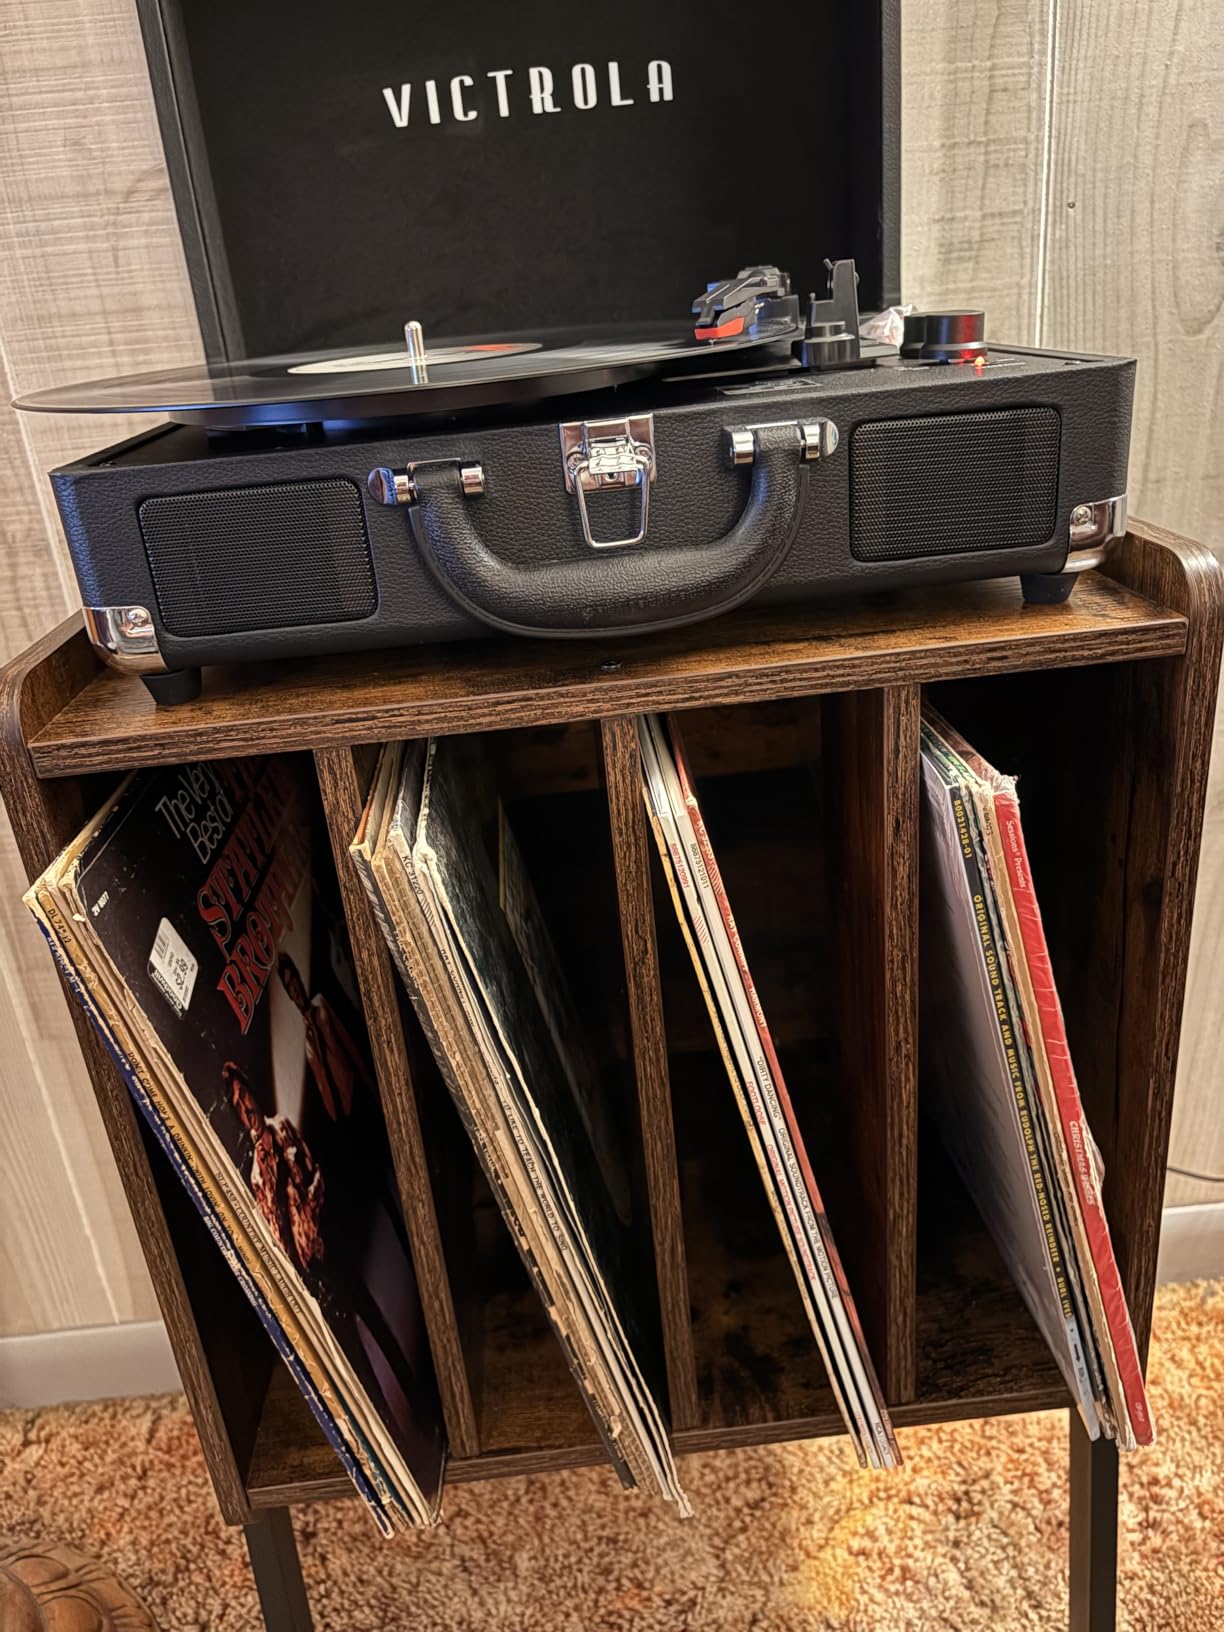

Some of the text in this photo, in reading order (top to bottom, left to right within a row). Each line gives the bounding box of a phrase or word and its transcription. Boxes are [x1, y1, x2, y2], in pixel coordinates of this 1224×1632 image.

[383, 60, 674, 128] VICTROLA
[155, 795, 196, 839] The
[187, 799, 227, 864] Best
[953, 799, 972, 859] B0021428-01
[690, 842, 710, 890] 88875121011
[1006, 819, 1026, 889] Sessions Presents
[401, 853, 424, 895] KC 31220
[506, 1113, 518, 1130] LIKE
[971, 893, 1073, 1319] ORIGINAL SOUND TRACK AND MUSIC FROM RUDOLPH THE RED-NOSED REINDEER BURL IVES
[514, 1133, 525, 1145] TO
[745, 1080, 766, 1127] FOOTLOOSE
[765, 1142, 782, 1177] ORIGINAL
[777, 1126, 795, 1162] ORIGINAL
[140, 1075, 158, 1098] COME
[225, 1223, 239, 1242] YO
[519, 1146, 538, 1173] TEACH
[531, 1174, 544, 1190] THE
[788, 1161, 810, 1210] SOUNDTRACK
[201, 1214, 214, 1229] BIG
[537, 1191, 556, 1220] WORLD
[803, 1210, 816, 1231] FROM
[234, 1204, 261, 1245] COUNTRY
[550, 1220, 561, 1232] TO
[554, 1232, 569, 1252] SING
[810, 1231, 821, 1245] THE
[814, 1244, 830, 1271] MOTION
[823, 1271, 839, 1300] PICTURE
